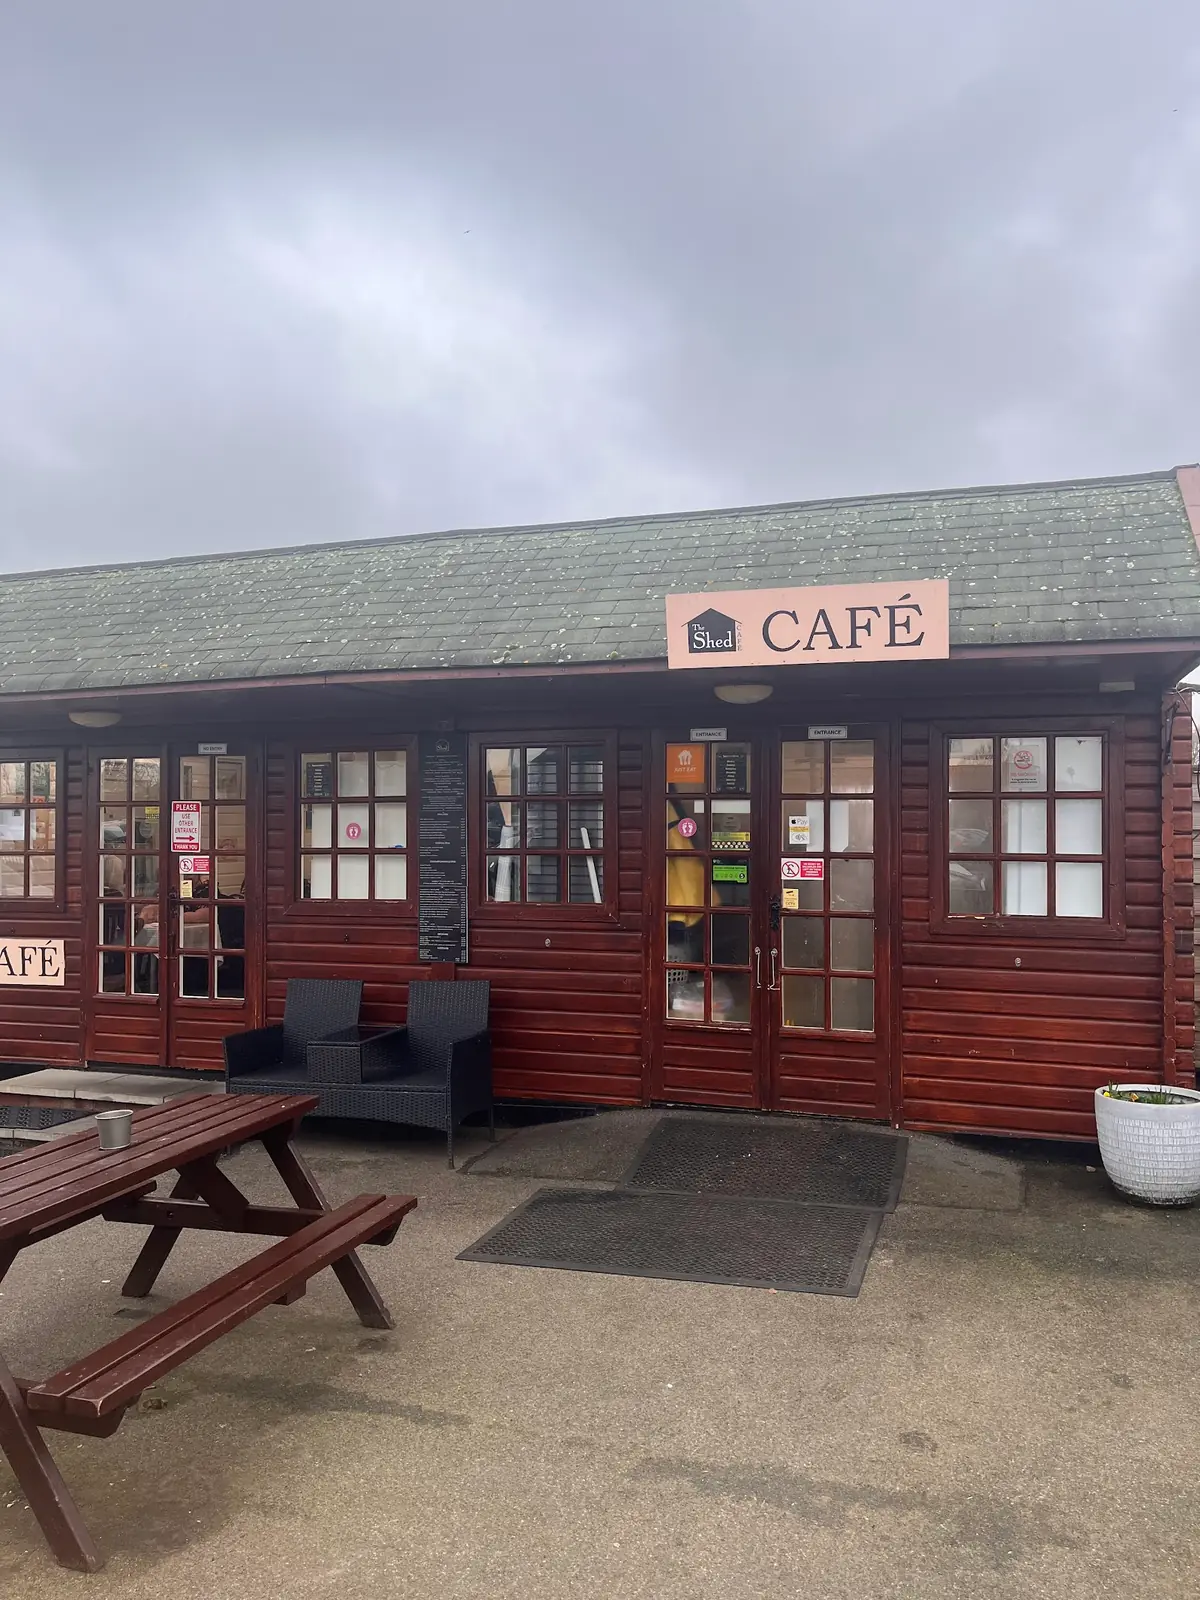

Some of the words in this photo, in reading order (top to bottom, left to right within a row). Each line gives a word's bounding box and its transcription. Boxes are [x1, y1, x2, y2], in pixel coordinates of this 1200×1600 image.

[692, 623, 705, 631] The
[762, 593, 926, 653] CAFÉ
[693, 630, 733, 649] Shed
[0, 939, 60, 977] AFÉ
